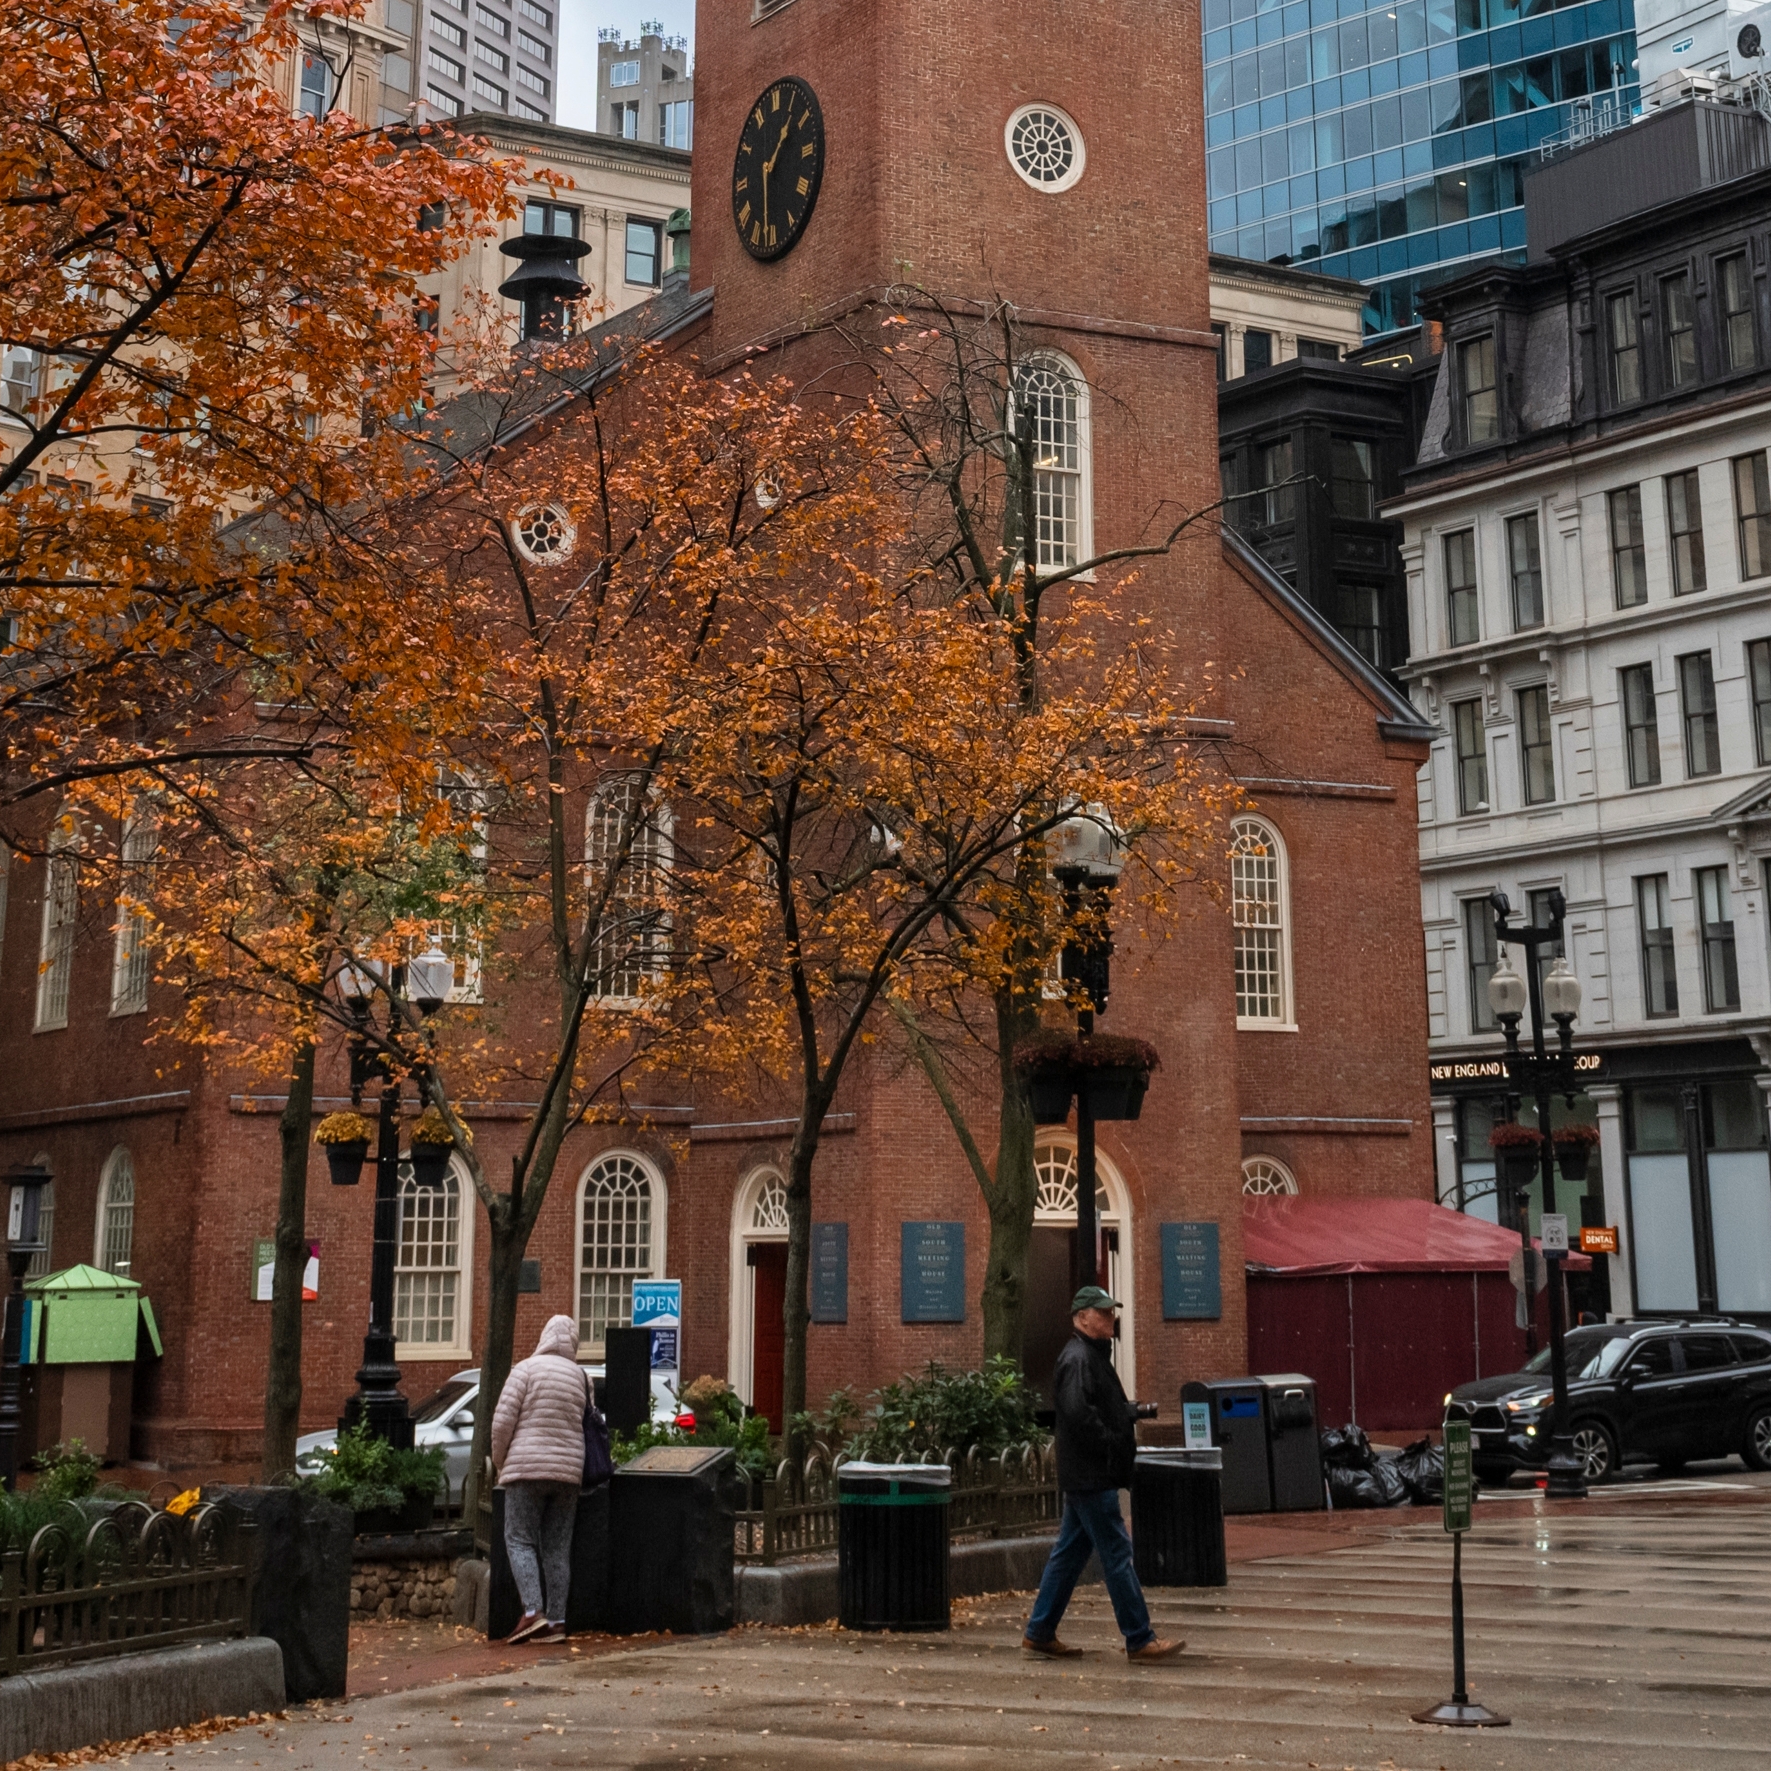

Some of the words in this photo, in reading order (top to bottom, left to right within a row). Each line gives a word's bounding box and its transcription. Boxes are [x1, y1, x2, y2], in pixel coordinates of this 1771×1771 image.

[1431, 1065, 1453, 1079] NEW
[1454, 1062, 1500, 1078] ENGLAND
[1585, 1235, 1614, 1244] DENTAL
[634, 1295, 679, 1312] OPEN
[1449, 1441, 1469, 1455] PLEASE
